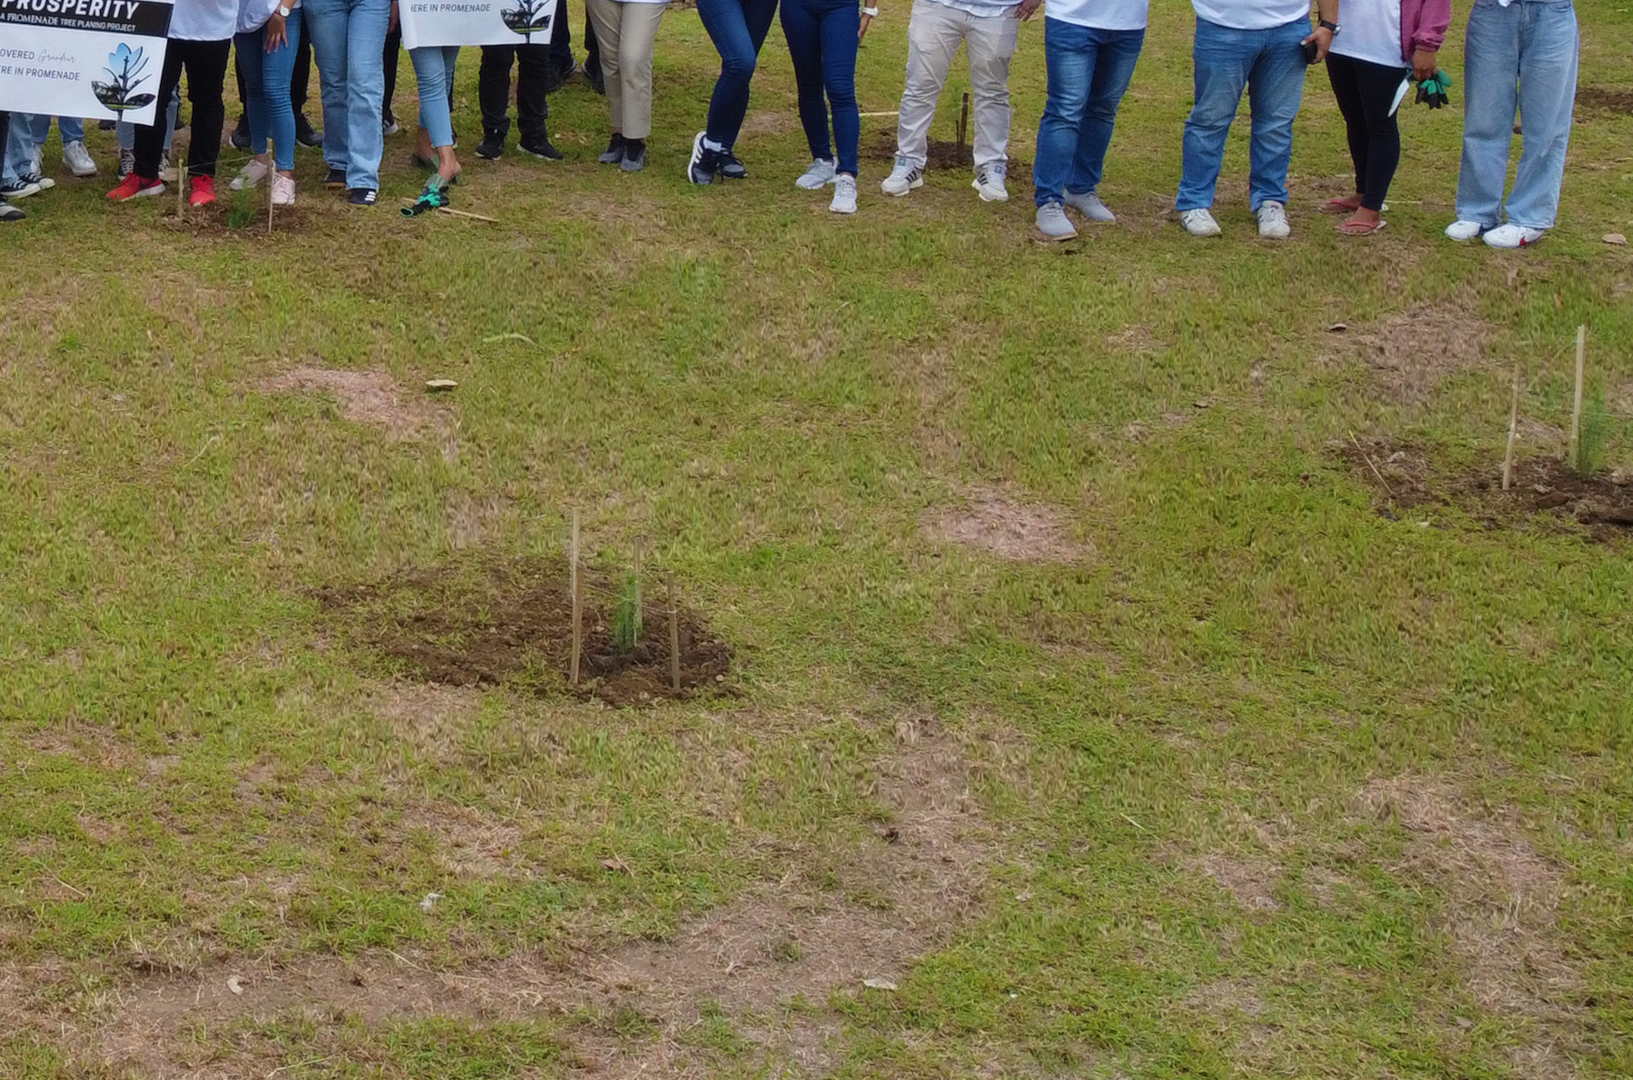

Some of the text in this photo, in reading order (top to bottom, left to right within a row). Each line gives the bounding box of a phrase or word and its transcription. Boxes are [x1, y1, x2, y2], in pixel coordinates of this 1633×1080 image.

[429, 3, 439, 12] IN
[440, 3, 491, 13] PROMENADE
[0, 12, 5, 20] A
[7, 12, 59, 26] PROMENADE
[60, 17, 77, 27] TREE
[106, 22, 136, 32] PROJECT
[14, 66, 24, 76] IN
[25, 67, 81, 81] PROMENADE
